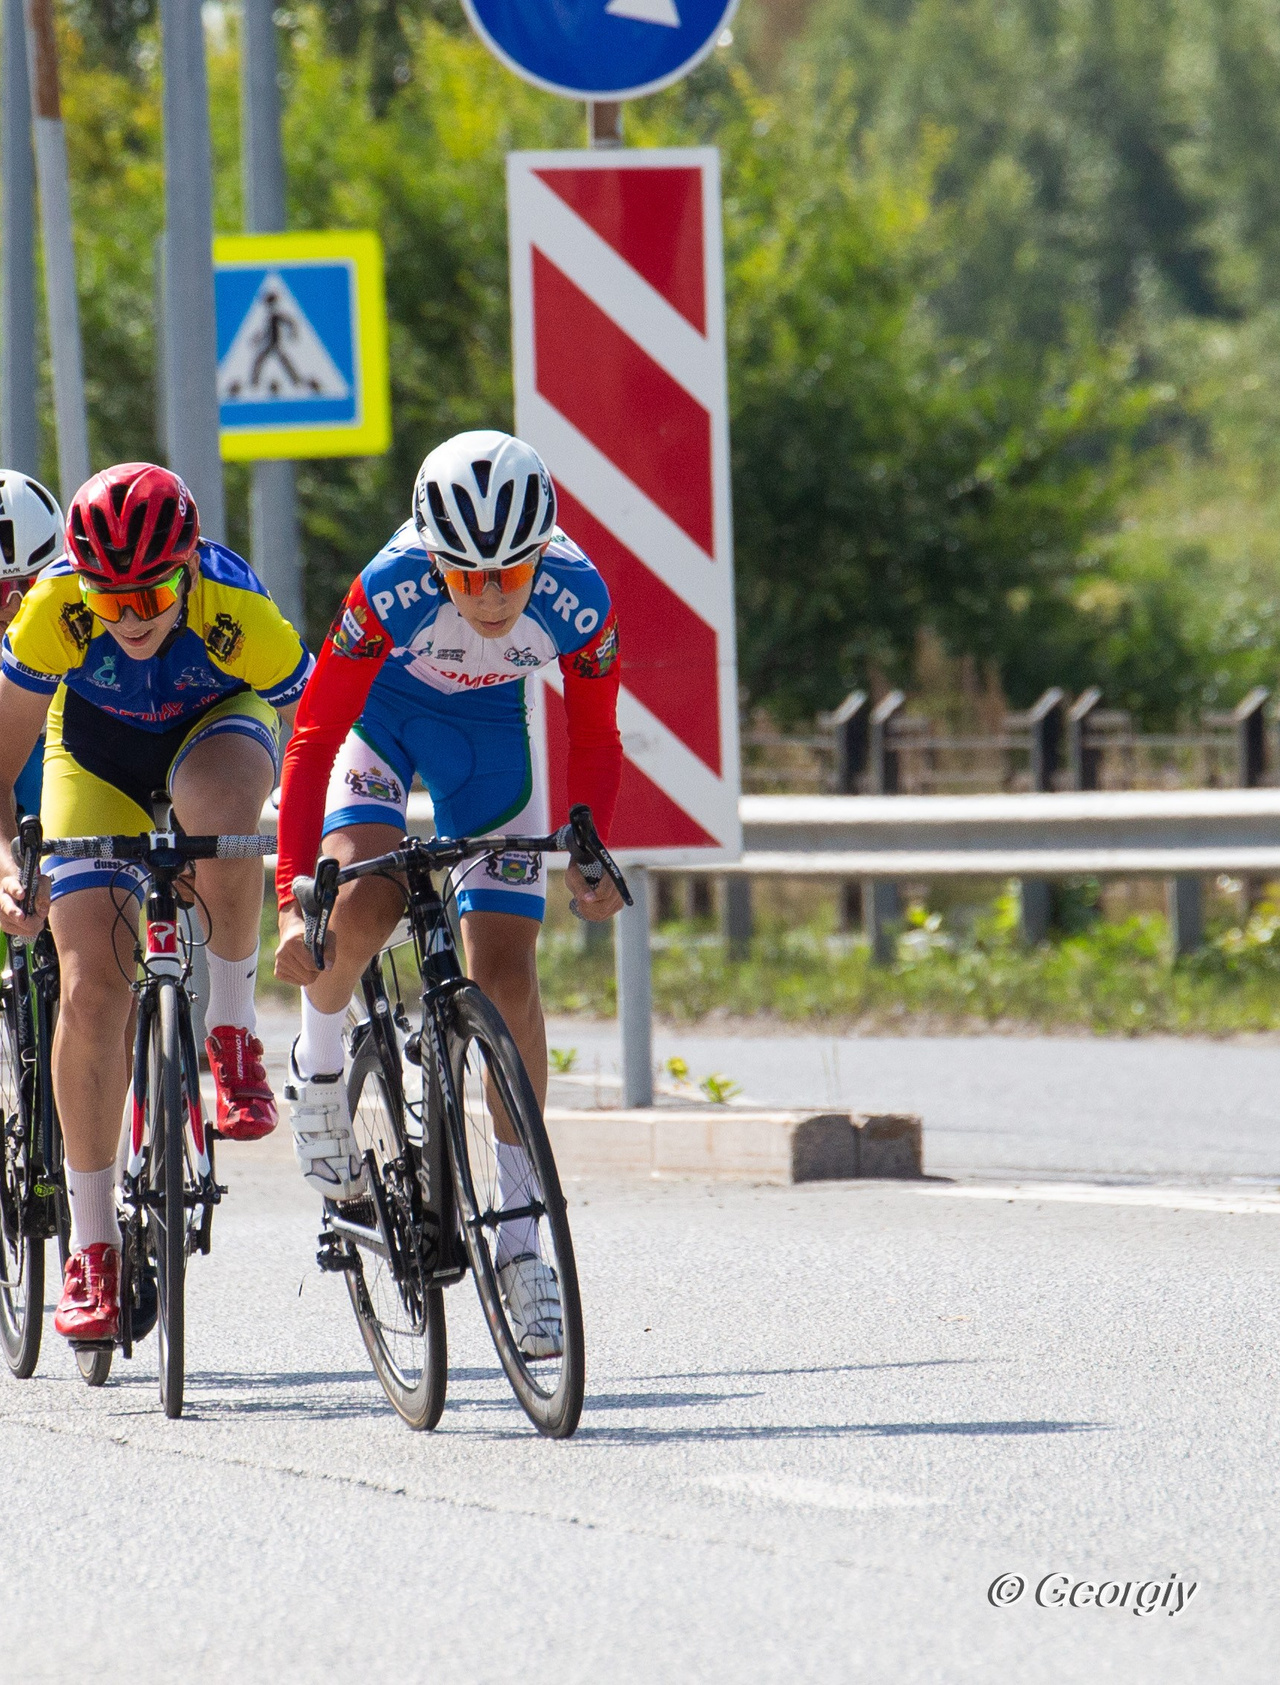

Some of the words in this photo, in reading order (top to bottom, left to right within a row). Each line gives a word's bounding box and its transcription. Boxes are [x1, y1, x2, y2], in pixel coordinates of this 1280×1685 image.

[371, 571, 439, 621] PRO
[533, 571, 599, 634] PRO
[316, 908, 329, 945] EMPIRE
